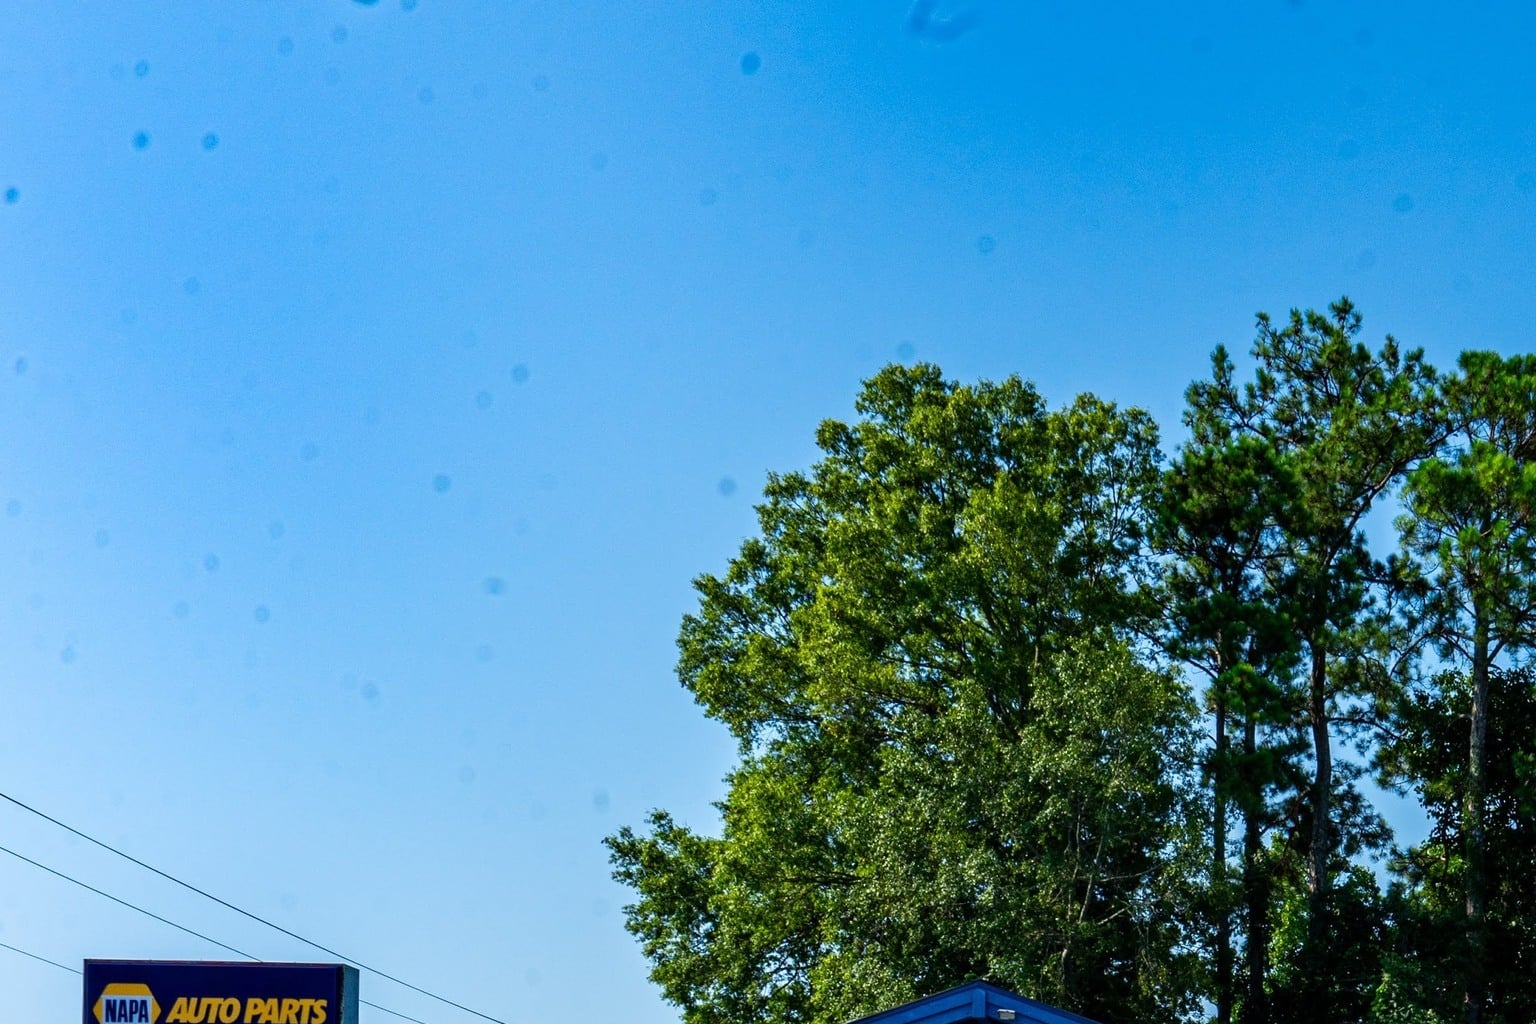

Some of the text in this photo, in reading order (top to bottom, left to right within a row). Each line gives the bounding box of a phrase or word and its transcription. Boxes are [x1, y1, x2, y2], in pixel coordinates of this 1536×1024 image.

[104, 997, 328, 1024] NAPA AUTO PARTS
